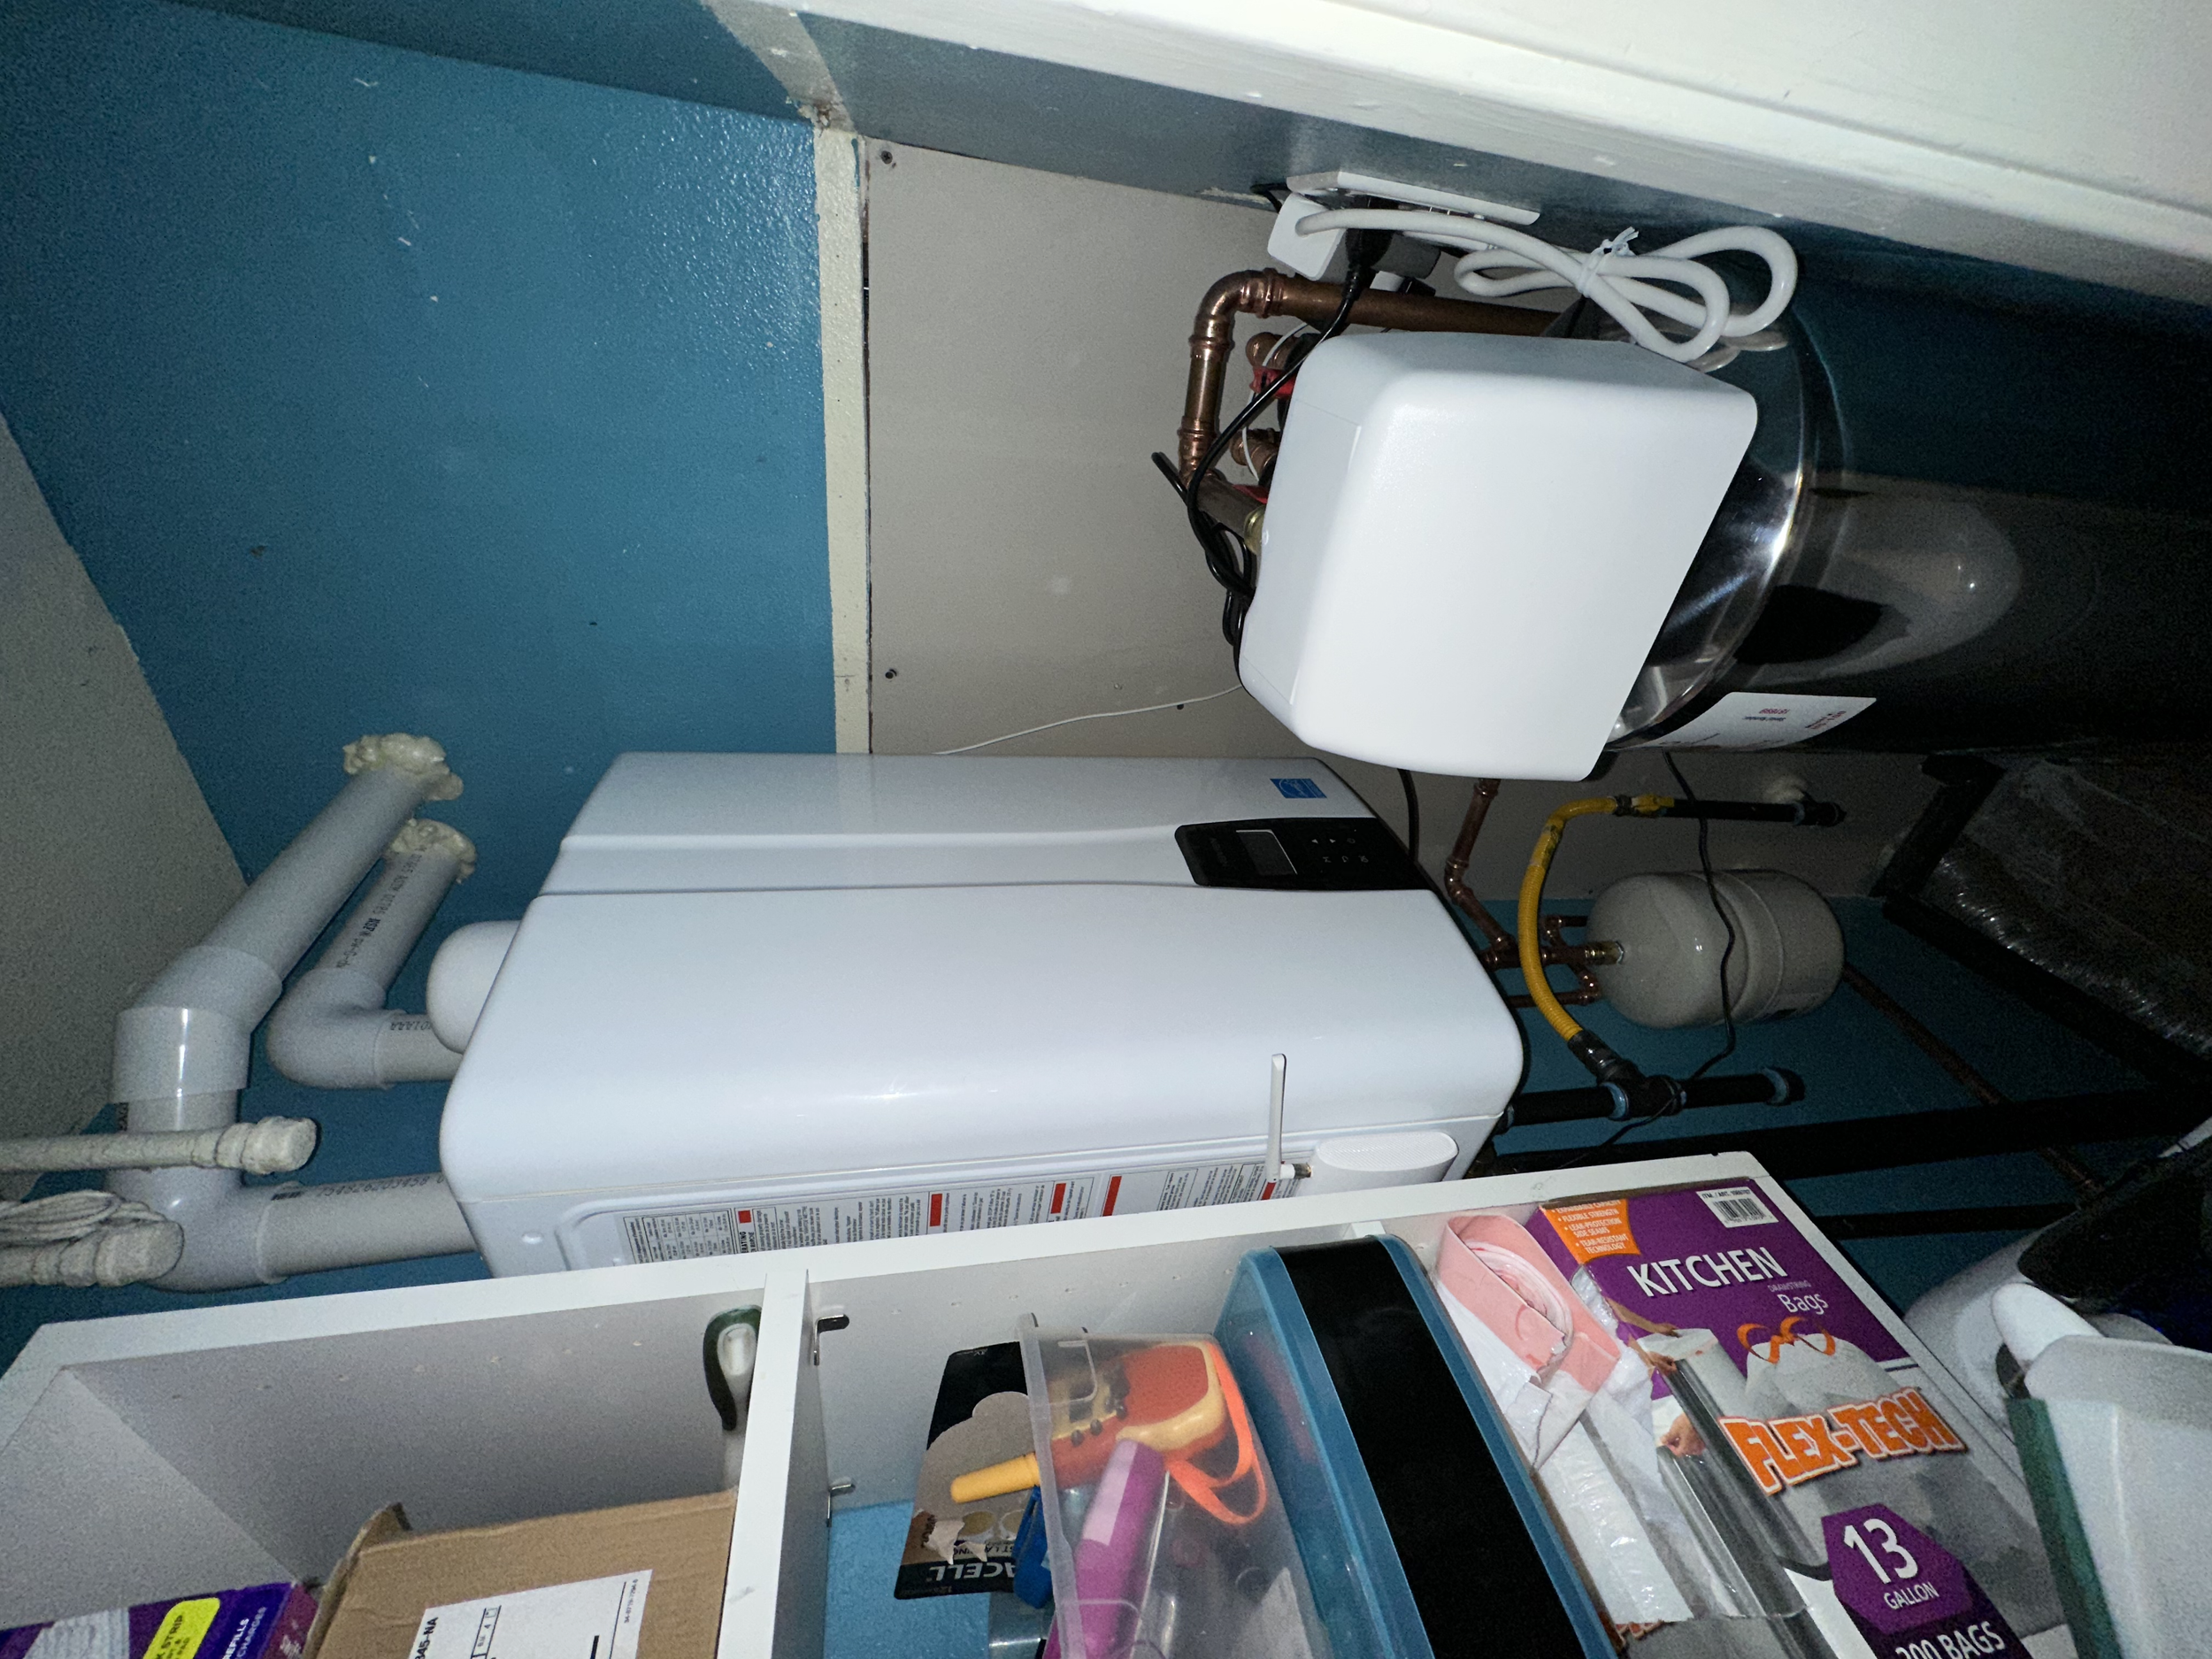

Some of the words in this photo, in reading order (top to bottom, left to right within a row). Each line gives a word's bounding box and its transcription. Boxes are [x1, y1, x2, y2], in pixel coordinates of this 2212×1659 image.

[1562, 1213, 1590, 1222] FLEXIBLE
[1588, 1209, 1620, 1218] STRENGTH
[740, 1231, 749, 1253] ERATING
[1573, 1229, 1590, 1238] SIDE
[1588, 1226, 1609, 1236] SEAMS
[1585, 1241, 1626, 1254] TECHNOLOGY
[1626, 1246, 1789, 1297] KITCHEN
[1777, 1292, 1829, 1315] Bags
[1718, 1386, 1969, 1495] FLEX-TECH
[1843, 1517, 1920, 1586] 13
[929, 1562, 1017, 1582] ACELL
[1883, 1581, 1939, 1610] GALLON
[161, 1615, 183, 1650] STRIP
[235, 1606, 268, 1659] CHARGES
[1937, 1621, 2006, 1659] BAGS
